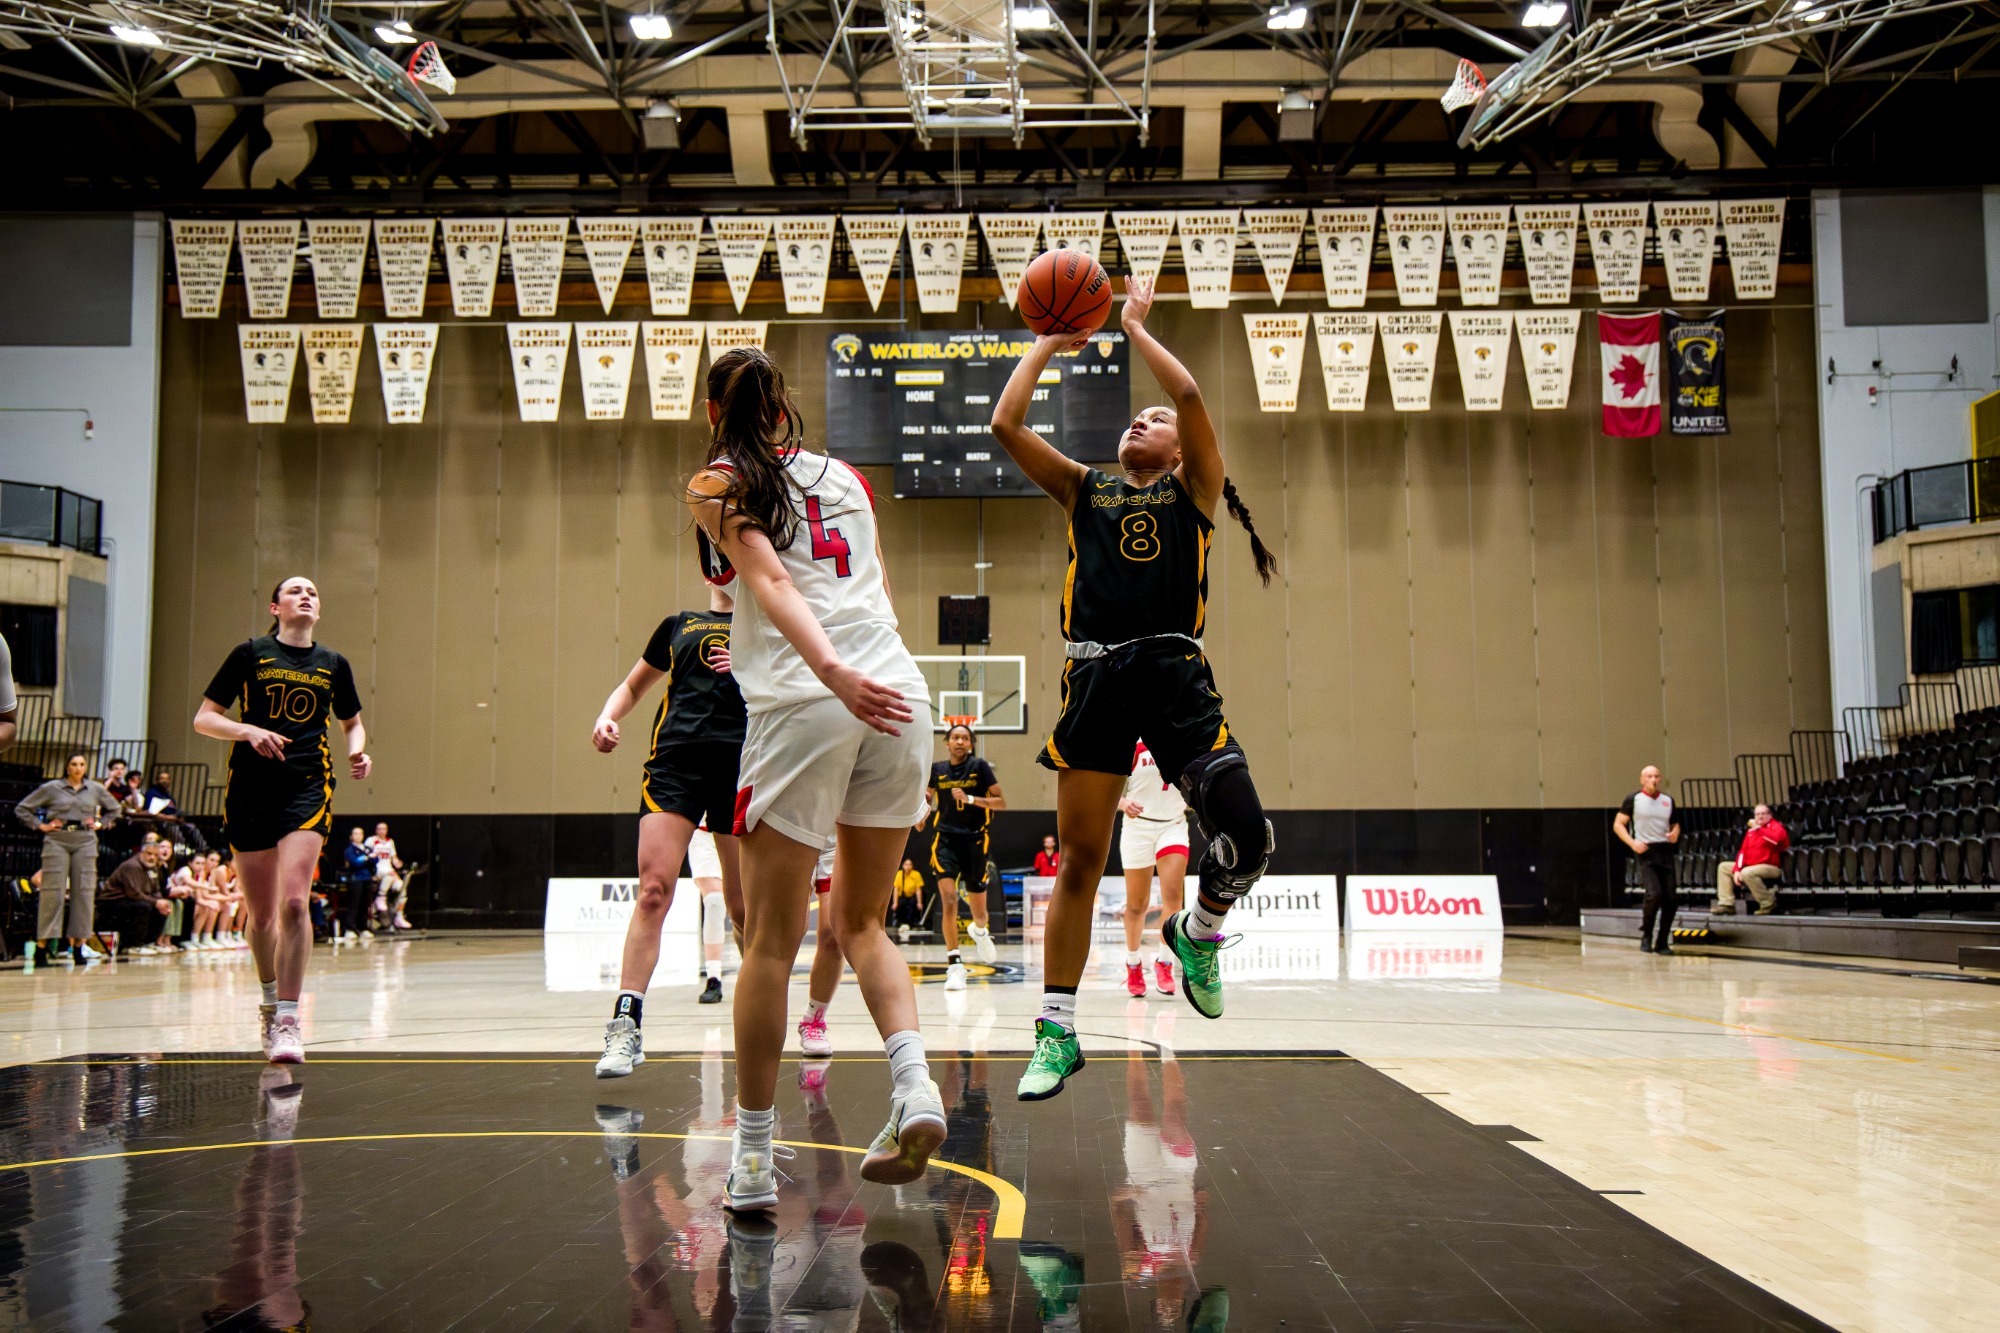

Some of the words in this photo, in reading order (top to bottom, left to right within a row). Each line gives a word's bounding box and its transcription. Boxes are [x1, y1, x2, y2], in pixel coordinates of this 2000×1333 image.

[1592, 208, 1640, 218] ONTARIO
[1663, 206, 1711, 216] ONTARIO
[1730, 204, 1776, 215] ONTARIO
[1251, 215, 1301, 224] NATIONAL
[1321, 213, 1368, 223] ONTARIO
[1392, 212, 1440, 222] ONTARIO
[1455, 211, 1501, 221] ONTARIO
[1524, 210, 1572, 220] ONTARIO
[1725, 214, 1782, 226] CHAMPIONS
[782, 221, 827, 230] ONTARIO
[849, 220, 899, 229] NATIONAL
[915, 220, 961, 229] ONTARIO
[986, 219, 1036, 228] NATIONAL
[1050, 218, 1096, 227] ONTARIO
[1119, 217, 1169, 226] NATIONAL
[1185, 216, 1231, 225] ONTARIO
[1520, 220, 1575, 230] CHAMPIONS
[1589, 218, 1644, 229] CHAMPIONS
[1659, 216, 1715, 227] CHAMPIONS
[451, 224, 496, 233] ONTARIO
[515, 224, 561, 233] ONTARIO
[583, 223, 633, 232] NATIONAL
[648, 222, 694, 232] ONTARIO
[717, 222, 766, 231] NATIONAL
[1181, 226, 1235, 236] CHAMPIONS
[1250, 225, 1302, 235] CHAMPIONS
[1317, 224, 1371, 234] CHAMPIONS
[1388, 222, 1443, 232] CHAMPIONS
[1451, 221, 1506, 231] CHAMPIONS
[718, 232, 766, 241] CHAMPIONS
[778, 232, 831, 241] CHAMPIONS
[849, 231, 899, 240] CHAMPIONS
[911, 231, 965, 240] CHAMPIONS
[987, 229, 1036, 238] CHAMPIONS
[1047, 228, 1100, 238] CHAMPIONS
[1120, 227, 1170, 237] CHAMPIONS
[511, 234, 564, 243] CHAMPIONS
[583, 233, 633, 242] CHAMPIONS
[645, 233, 697, 242] CHAMPIONS
[1255, 319, 1298, 329] ONTARIO
[1323, 315, 1368, 325] ONTARIO
[1387, 315, 1432, 324] ONTARIO
[1461, 317, 1503, 327] ONTARIO
[1525, 316, 1569, 326] ONTARIO
[248, 330, 291, 339] ONTARIO
[311, 330, 354, 338] ONTARIO
[518, 329, 561, 338] ONTARIO
[586, 329, 629, 337] ONTARIO
[653, 328, 695, 337] ONTARIO
[716, 327, 757, 336] ONTARIO
[1250, 329, 1303, 339] CHAMPIONS
[1318, 325, 1373, 336] CHAMPIONS
[1382, 325, 1438, 335] CHAMPIONS
[1456, 328, 1507, 337] CHAMPIONS
[1520, 326, 1576, 336] CHAMPIONS
[512, 339, 567, 348] CHAMPIONS
[580, 339, 633, 348] CHAMPIONS
[646, 338, 700, 347] CHAMPIONS
[710, 338, 762, 346] CHAMPIONS
[949, 334, 971, 343] HOME
[972, 334, 983, 343] OF
[984, 334, 999, 343] THE
[869, 343, 975, 359] WATERLOO
[871, 367, 883, 377] PTS
[1031, 389, 1050, 401] EST
[1698, 385, 1720, 395] ARE
[905, 390, 935, 403] HOME
[965, 395, 991, 404] PERIOD
[1672, 416, 1725, 428] UNITED
[902, 425, 926, 435] FOULS
[956, 425, 983, 435] PLAYER
[1031, 424, 1055, 434] FOULS
[902, 453, 925, 462] SCORE
[965, 452, 991, 462] MATCH
[913, 468, 920, 477] 1
[955, 467, 962, 477] 2
[995, 467, 1002, 476] 3
[805, 495, 852, 578] 4
[1120, 511, 1161, 562] 8
[266, 683, 317, 723] 10
[1232, 889, 1322, 918] mprint
[1362, 887, 1484, 916] Wilson
